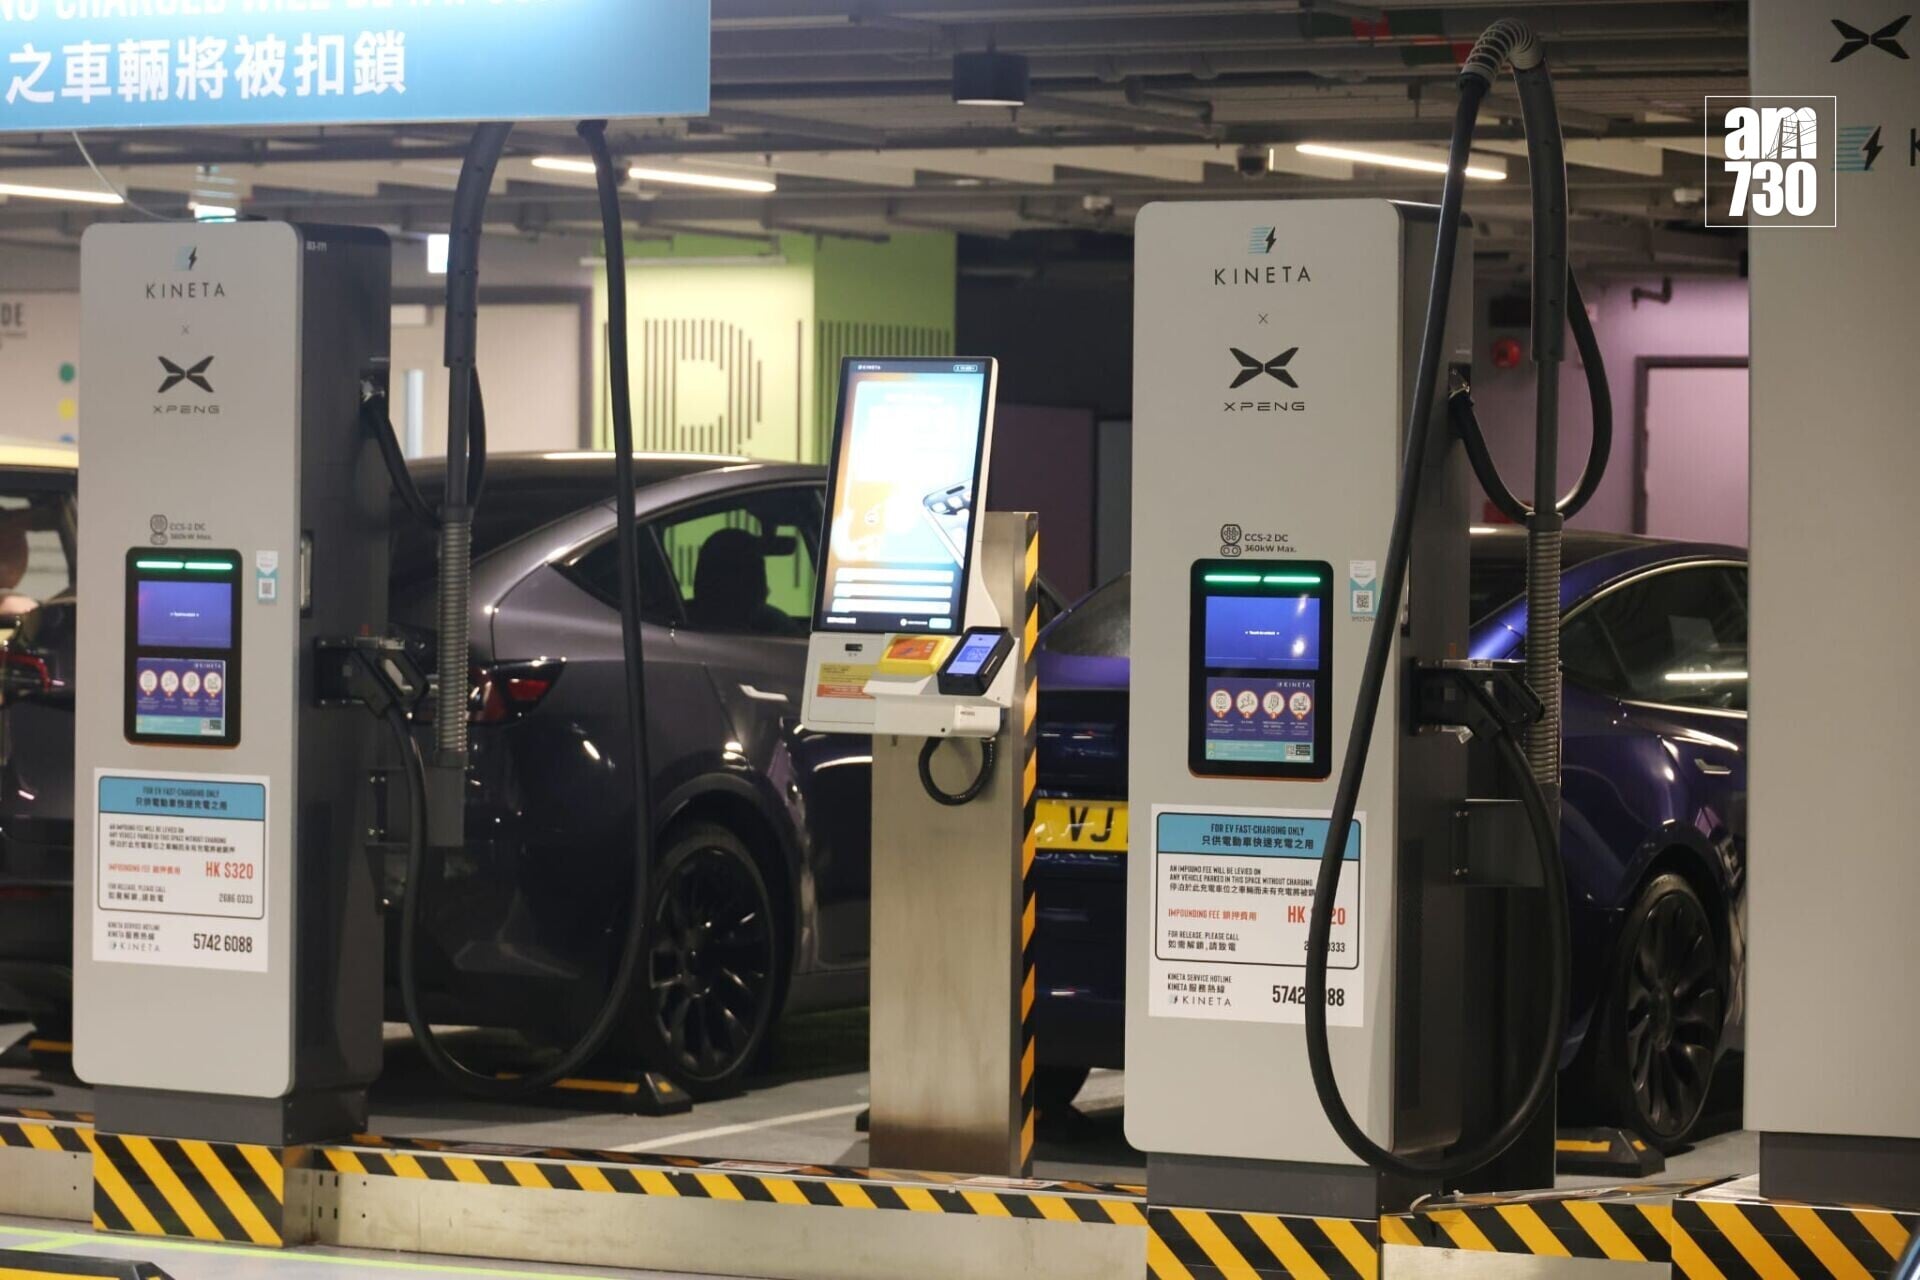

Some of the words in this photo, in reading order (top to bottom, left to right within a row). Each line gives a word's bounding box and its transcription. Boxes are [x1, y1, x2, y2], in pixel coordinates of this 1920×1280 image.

[7, 29, 407, 104] 之車輛將被扣鎖
[1214, 266, 1311, 286] KINETA
[146, 283, 226, 299] KINETA
[154, 405, 220, 414] XPENG
[1224, 402, 1305, 412] XPENG
[1245, 533, 1272, 542] CCS-2
[1275, 534, 1289, 542] DC
[1277, 545, 1297, 553] Max.
[1069, 806, 1114, 842] VJ
[1211, 824, 1224, 833] FOR
[1225, 824, 1234, 833] EV
[1288, 827, 1305, 836] ONLY
[1202, 835, 1314, 850] 只供電動車快速充電之用
[206, 861, 221, 877] HK
[1203, 866, 1212, 874] FEE
[1168, 909, 1208, 918] IMPOUNDING
[1209, 910, 1220, 919] FEE
[1288, 906, 1306, 923] HK
[1168, 930, 1178, 938] FOR
[1205, 932, 1225, 940] PLEASE
[1226, 933, 1240, 941] CALL
[194, 934, 221, 951] 5742
[225, 935, 253, 953] 6088
[1187, 974, 1209, 982] SERVICE
[1168, 983, 1188, 991] KINETA
[1272, 985, 1306, 1005] 5742
[1183, 996, 1232, 1007] KINETA
